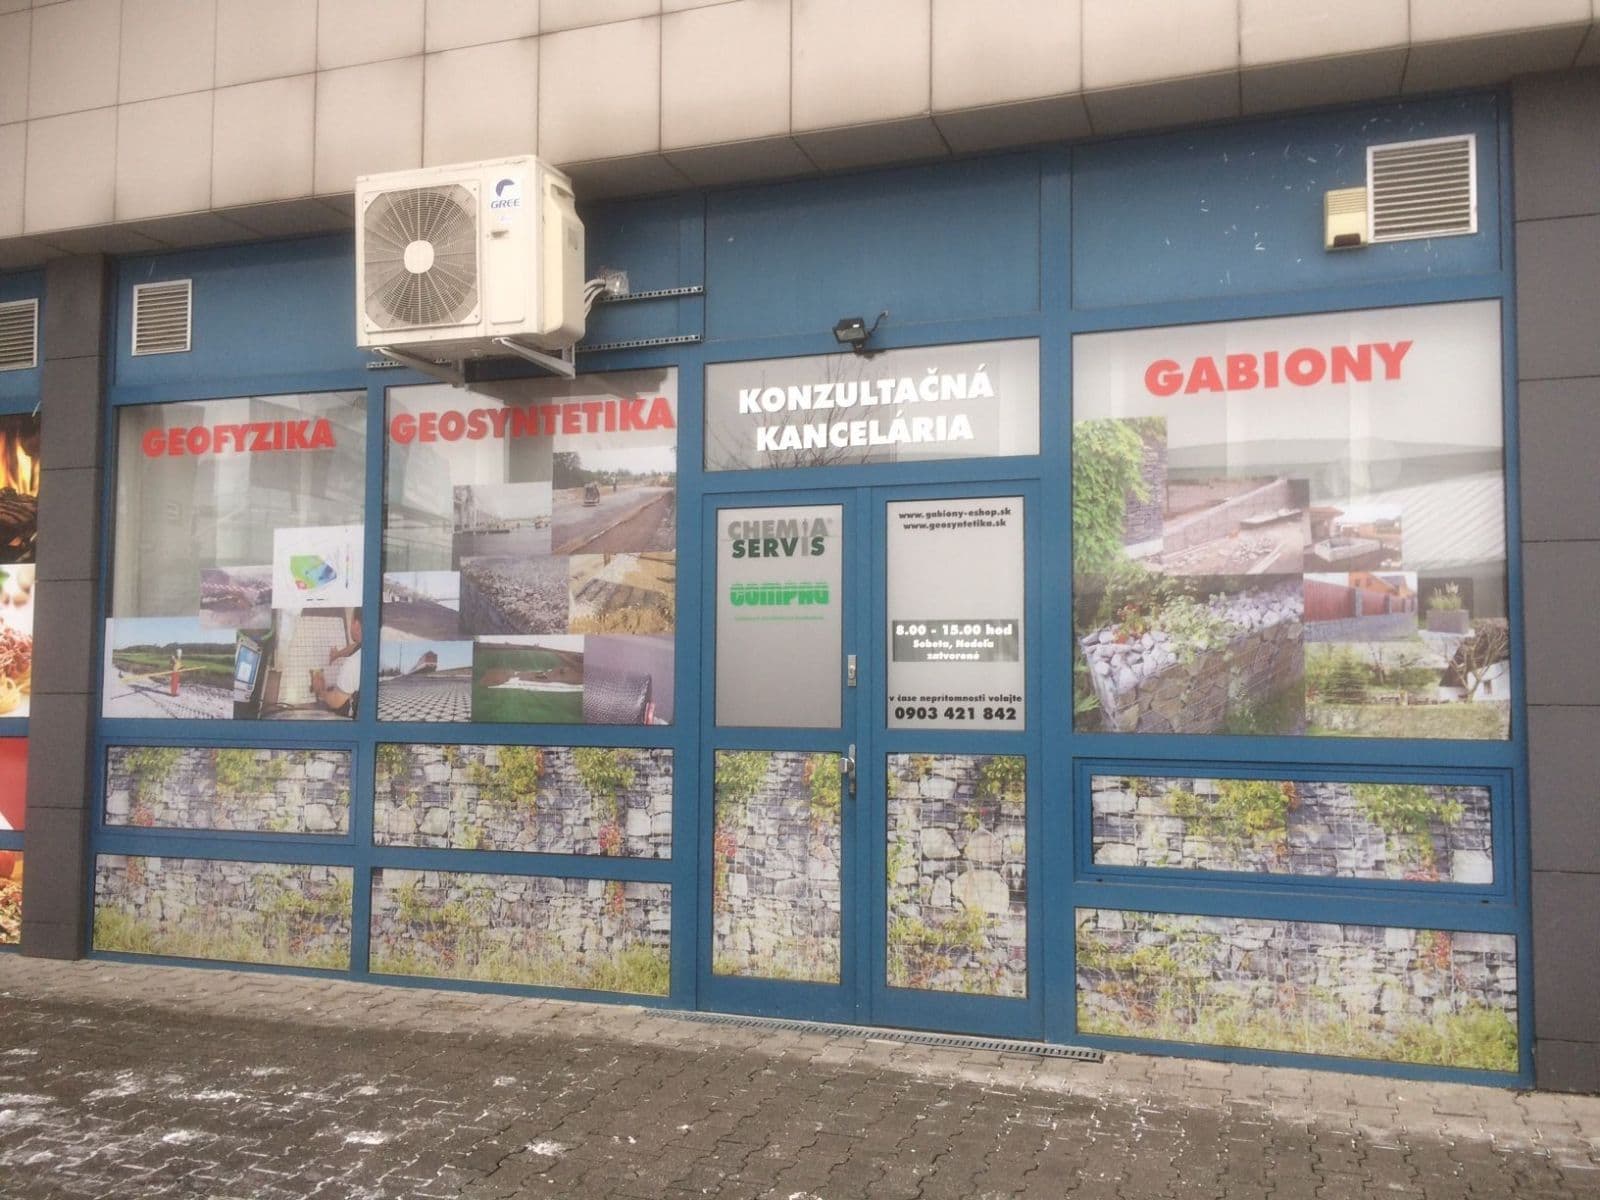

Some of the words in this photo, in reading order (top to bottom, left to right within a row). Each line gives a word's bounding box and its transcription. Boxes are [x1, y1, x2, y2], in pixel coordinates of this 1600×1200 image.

[491, 198, 520, 209] GREE
[1144, 340, 1413, 397] GABIONY
[738, 363, 995, 414] KONZULTAČNÁ
[389, 397, 677, 444] GEOSYNTETIKA
[756, 411, 975, 451] KANCELÁRIA
[141, 416, 335, 458] GEOFYZIKA
[898, 507, 1012, 520] www.gabiony-eshop.sk
[727, 518, 829, 539] CHEMIA
[903, 518, 1007, 531] www.geosyntetika.sk
[731, 536, 826, 558] SERVIS
[895, 624, 927, 636] 8.00
[942, 624, 982, 636] 15.00
[985, 623, 1013, 636] hod
[988, 693, 1023, 704] volajte
[894, 706, 938, 720] 0903
[943, 706, 975, 720] 421
[982, 706, 1017, 720] 842
